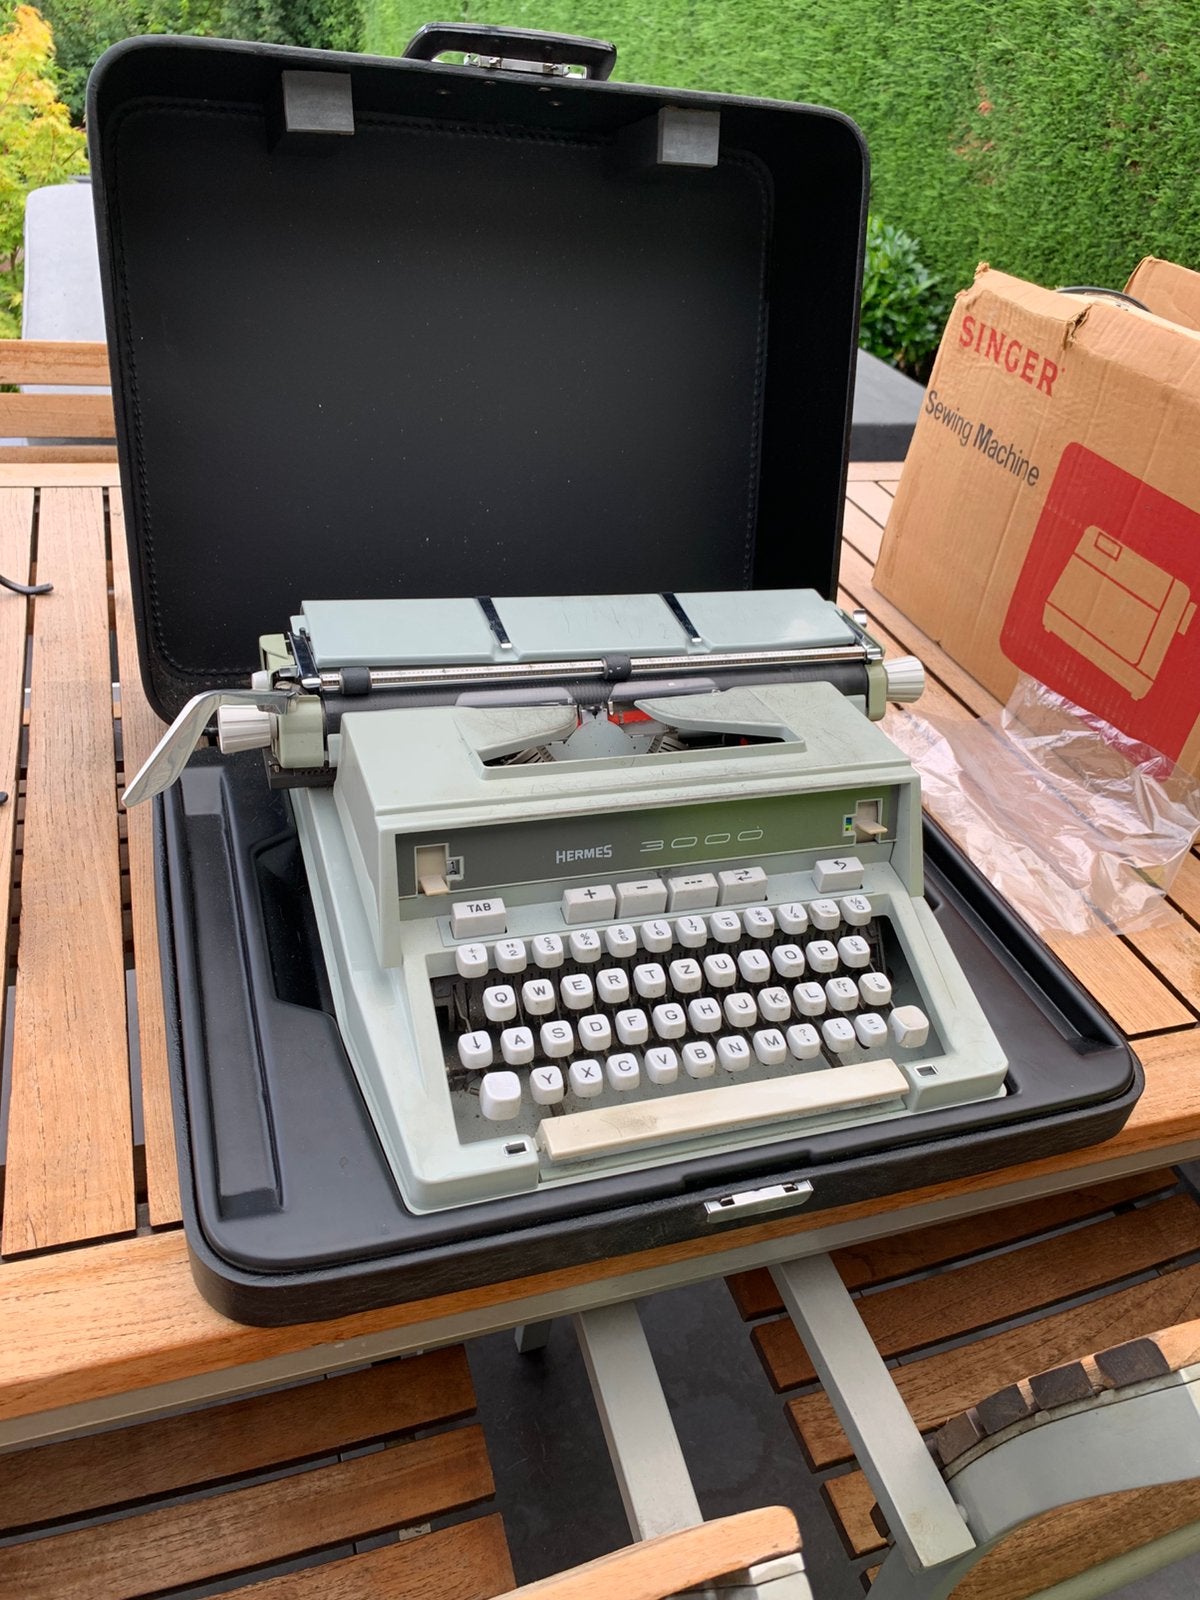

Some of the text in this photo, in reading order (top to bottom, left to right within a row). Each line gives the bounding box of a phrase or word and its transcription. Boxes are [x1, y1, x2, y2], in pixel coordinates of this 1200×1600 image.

[959, 315, 1059, 397] SINGER
[925, 390, 1040, 486] Sewing Machine
[555, 829, 764, 864] HERMES 3000
[466, 902, 492, 913] TAB
[785, 951, 797, 959] O
[818, 947, 828, 955] P
[715, 960, 727, 969] U
[753, 956, 759, 964] I
[645, 970, 654, 978] T
[681, 965, 694, 974] Z
[608, 975, 620, 984] R
[572, 980, 585, 990] E
[533, 986, 545, 995] W
[805, 990, 818, 998] L
[495, 993, 507, 1003] Q
[770, 994, 783, 1003] K
[739, 999, 748, 1009] J
[701, 1005, 713, 1014] H
[665, 1010, 677, 1020] G
[628, 1016, 636, 1026] F
[590, 1022, 602, 1031] D
[552, 1028, 565, 1038] S
[515, 1035, 525, 1045] A
[764, 1036, 780, 1046] M
[729, 1043, 742, 1052] N
[694, 1049, 707, 1058] B
[657, 1054, 666, 1064] V
[618, 1061, 631, 1071] C
[582, 1067, 594, 1078] X
[542, 1074, 552, 1084] Y
